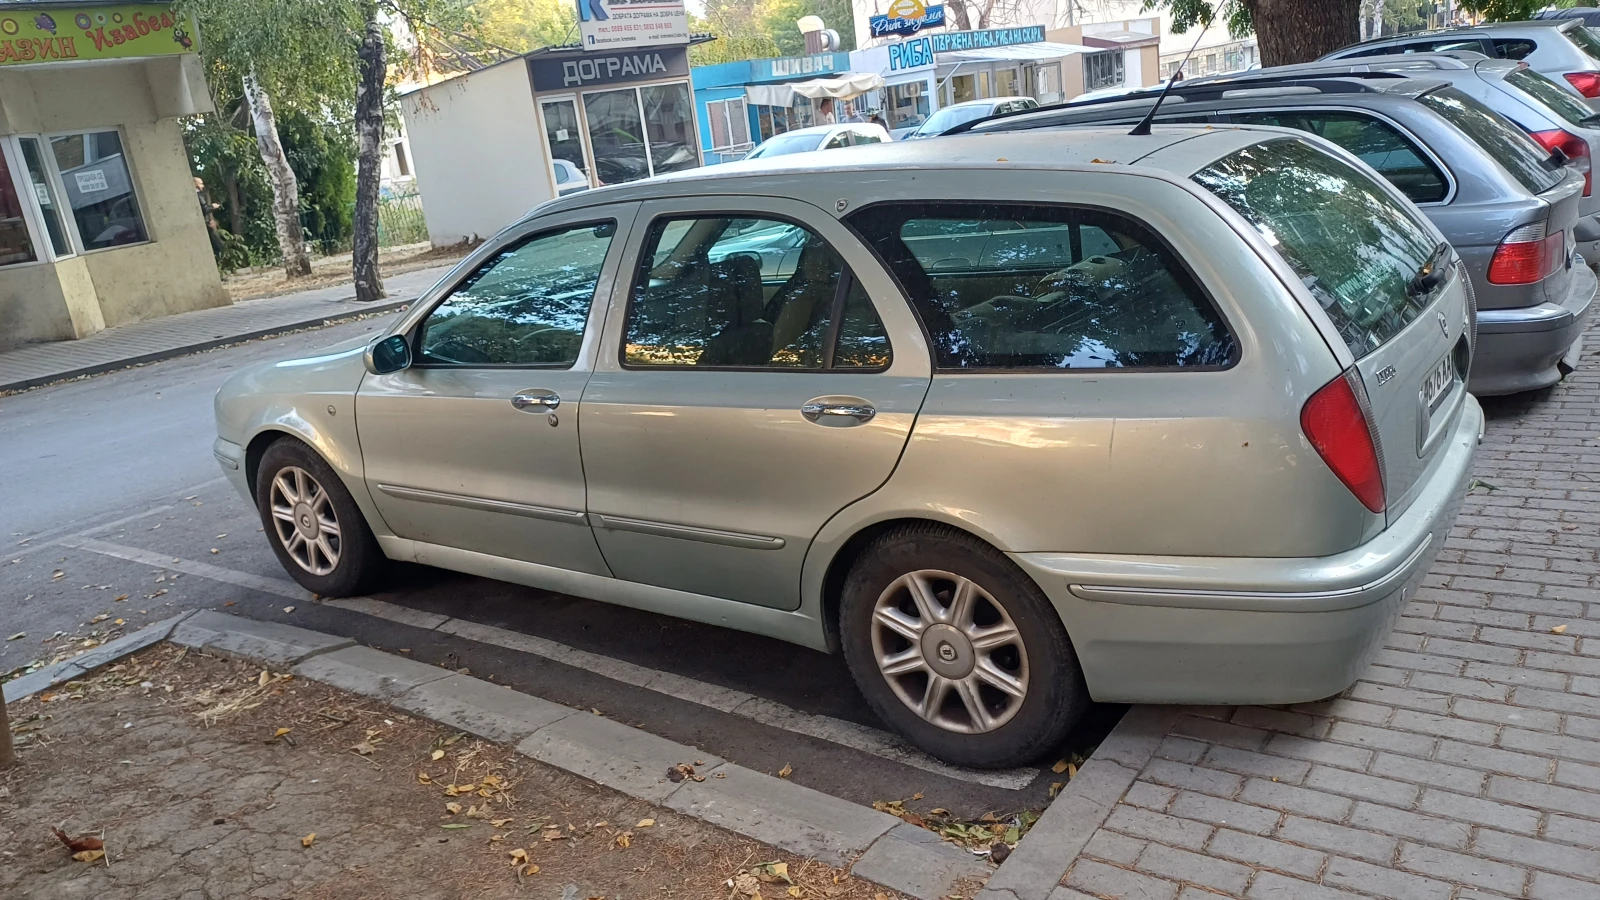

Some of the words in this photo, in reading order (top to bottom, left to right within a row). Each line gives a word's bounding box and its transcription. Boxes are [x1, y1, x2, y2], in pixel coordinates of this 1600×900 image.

[932, 34, 973, 51] ПЪРЖЕНА
[1013, 28, 1023, 43] НА
[771, 55, 833, 76] ШИВАЧ
[888, 37, 934, 71] РИБА
[563, 54, 667, 86] ДОГРАМА
